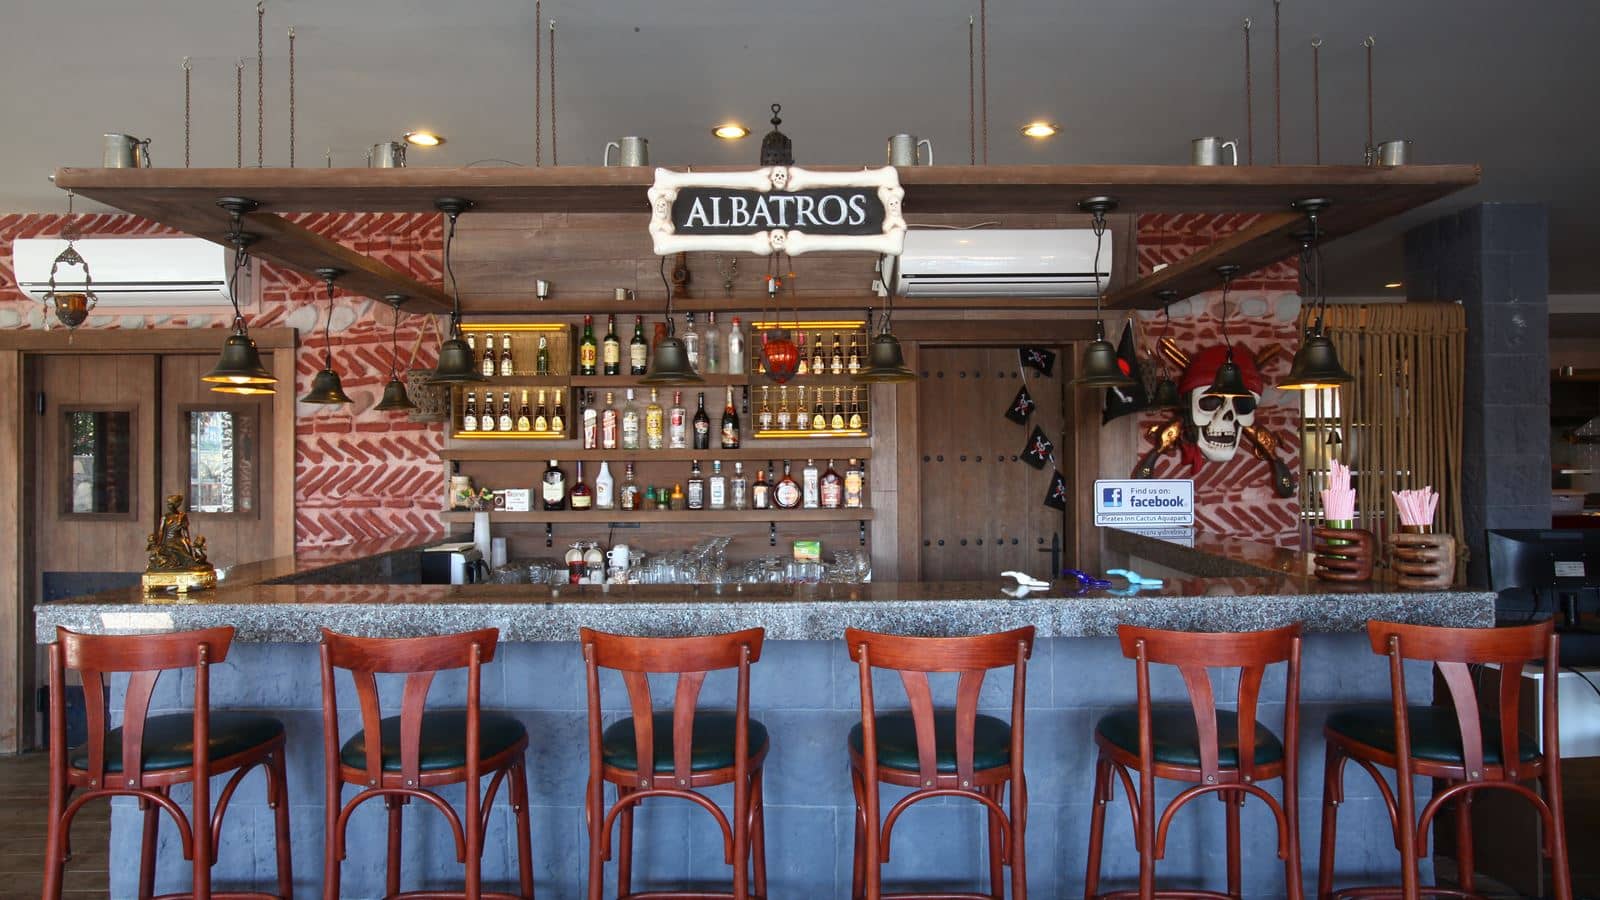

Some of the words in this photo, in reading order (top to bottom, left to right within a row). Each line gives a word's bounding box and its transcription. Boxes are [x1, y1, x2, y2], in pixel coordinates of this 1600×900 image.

[683, 194, 867, 228] ALBATROS
[1130, 496, 1184, 507] facebook
[1158, 515, 1187, 523] Aquapark
